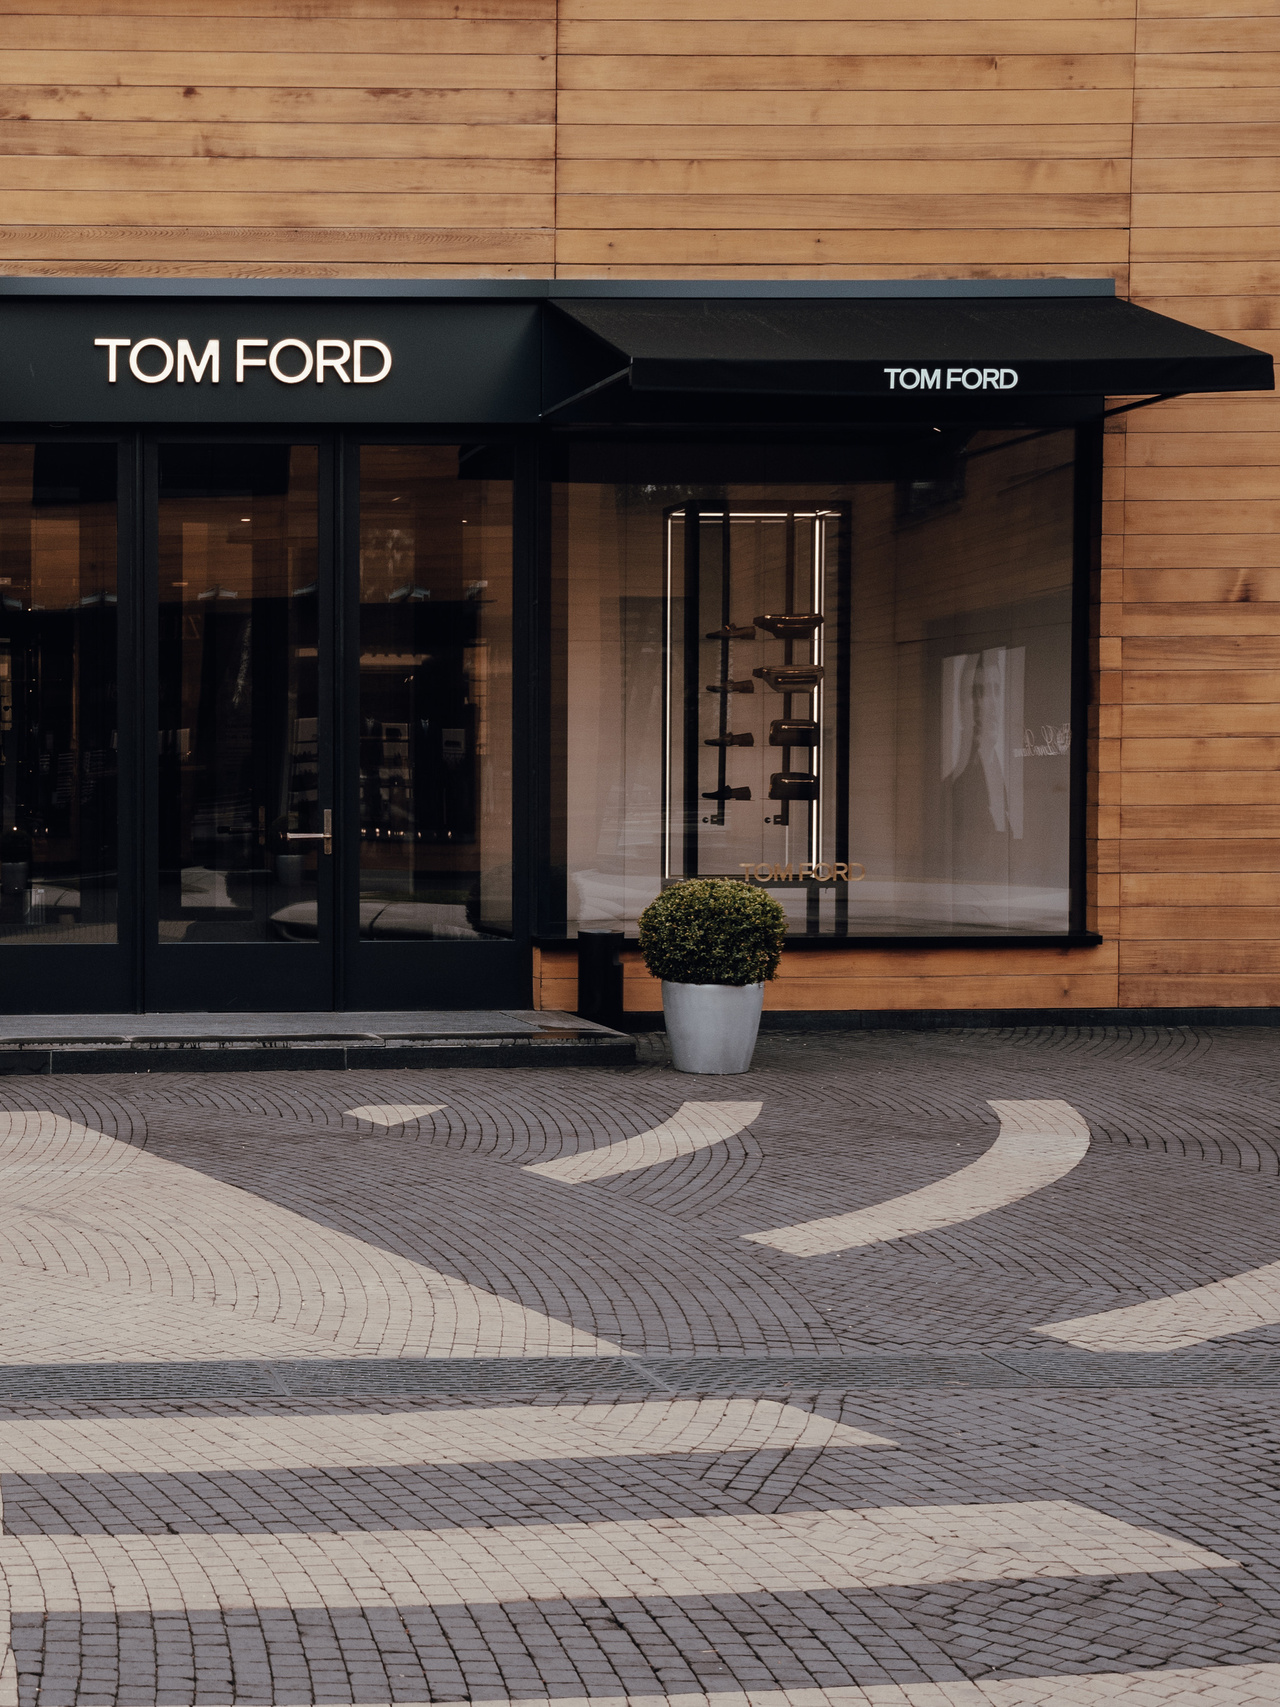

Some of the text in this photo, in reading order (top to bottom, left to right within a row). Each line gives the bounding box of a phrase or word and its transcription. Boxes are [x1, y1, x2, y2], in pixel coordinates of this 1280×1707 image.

[94, 338, 392, 384] TOM FORD
[883, 367, 1019, 390] TOM FORD
[738, 862, 866, 882] TOM FORD
